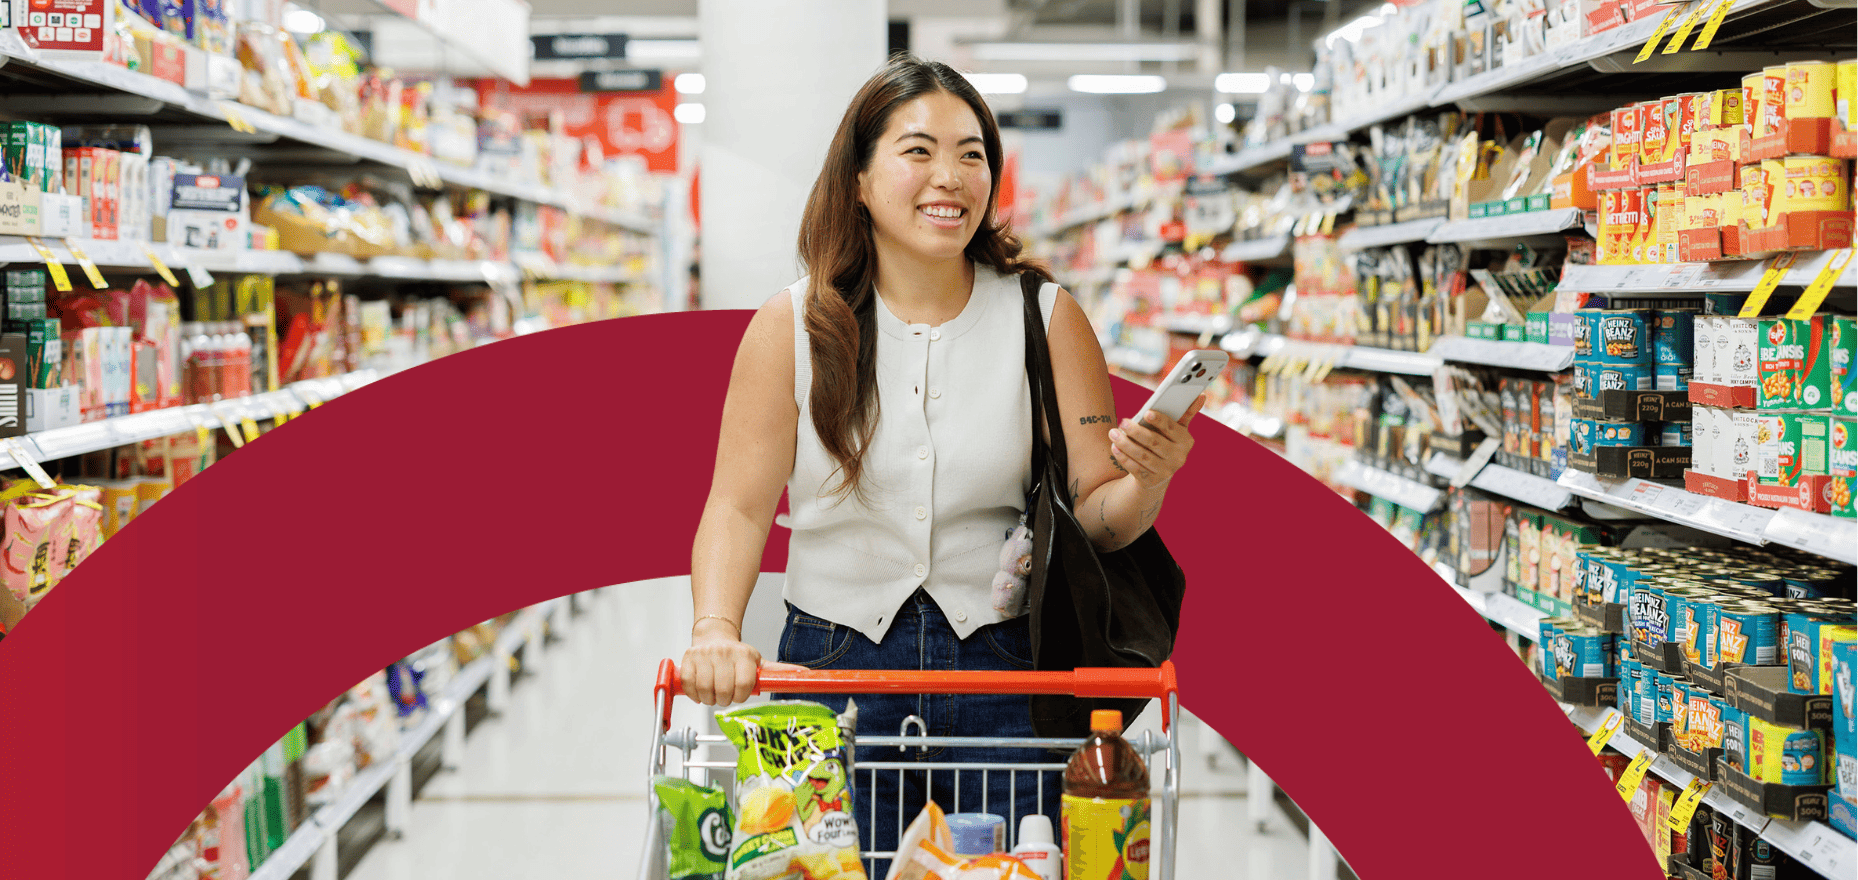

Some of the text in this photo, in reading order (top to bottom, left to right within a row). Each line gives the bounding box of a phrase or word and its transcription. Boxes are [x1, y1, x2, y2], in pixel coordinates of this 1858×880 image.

[1607, 319, 1629, 328] HEINZ
[1605, 327, 1634, 338] BEANZ
[1642, 405, 1659, 413] 220g
[1632, 461, 1649, 469] 220g
